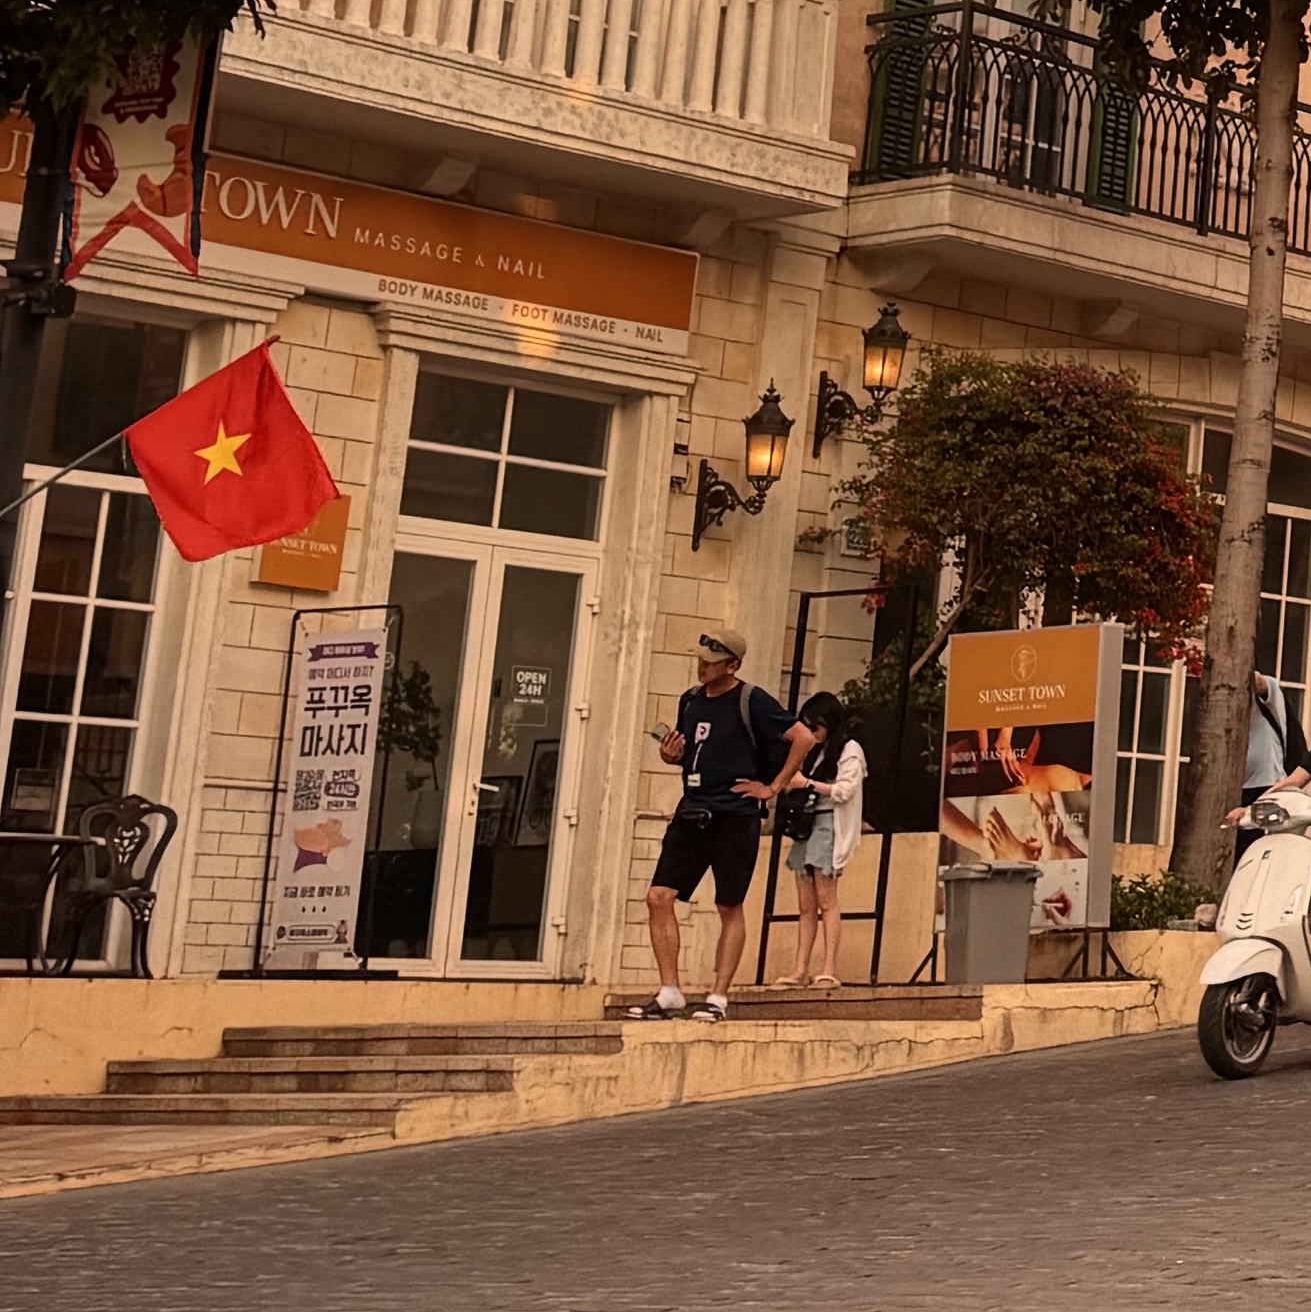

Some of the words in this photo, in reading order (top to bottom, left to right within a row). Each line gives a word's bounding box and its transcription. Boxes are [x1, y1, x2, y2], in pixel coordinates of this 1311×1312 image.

[201, 170, 344, 239] TOWN
[354, 227, 464, 264] MASSAGE
[497, 255, 546, 280] NAIL
[378, 278, 418, 298] BODY
[421, 286, 489, 311] MASSAGE
[511, 303, 549, 322] FOOT
[551, 312, 616, 335] MASSAGE
[635, 325, 664, 343] NAIL
[516, 671, 547, 684] OPEN
[519, 683, 543, 696] 24H
[978, 688, 1026, 704] SUNSET
[1029, 684, 1066, 700] TOWN
[304, 684, 372, 719] 푸꾸옥
[300, 722, 368, 758] 마사지
